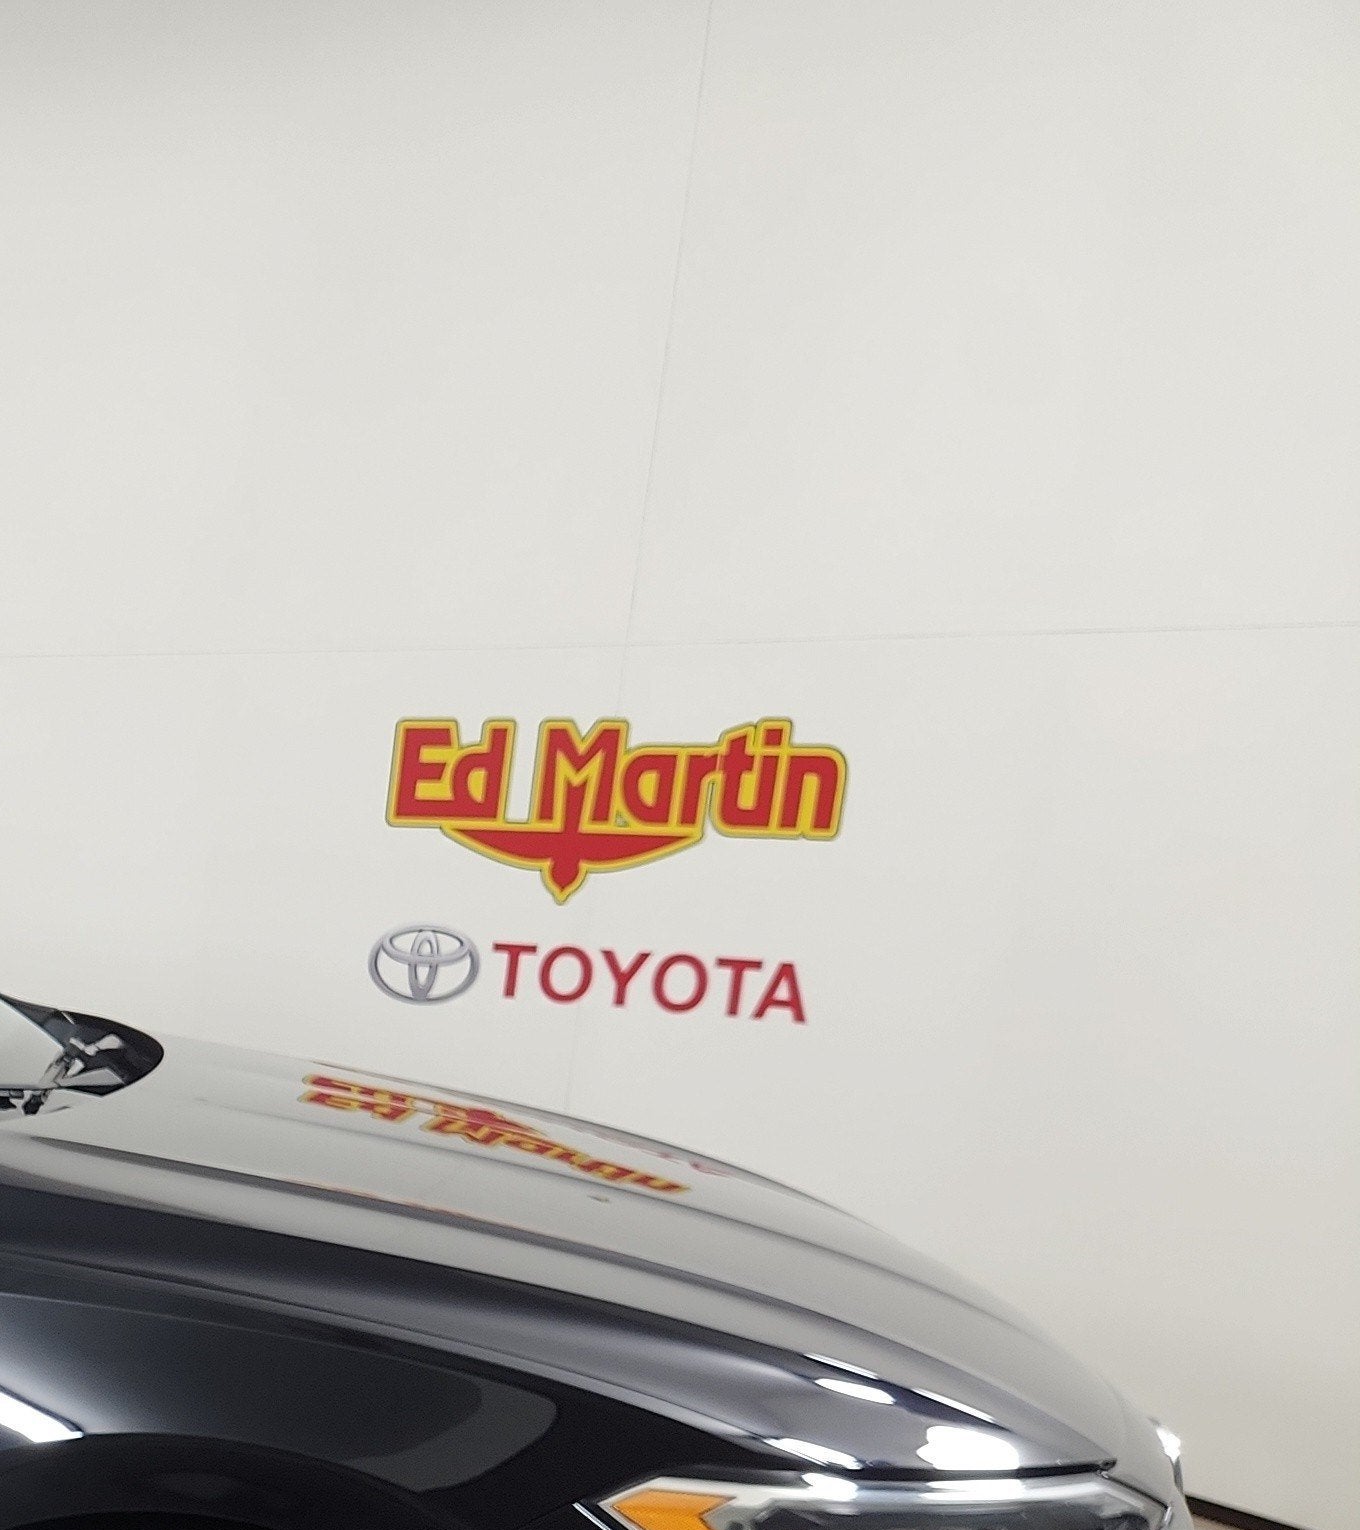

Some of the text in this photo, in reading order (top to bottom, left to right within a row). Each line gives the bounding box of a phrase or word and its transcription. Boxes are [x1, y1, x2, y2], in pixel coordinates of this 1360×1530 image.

[391, 722, 843, 835] Ed Martin
[492, 942, 808, 1024] TOYOTA
